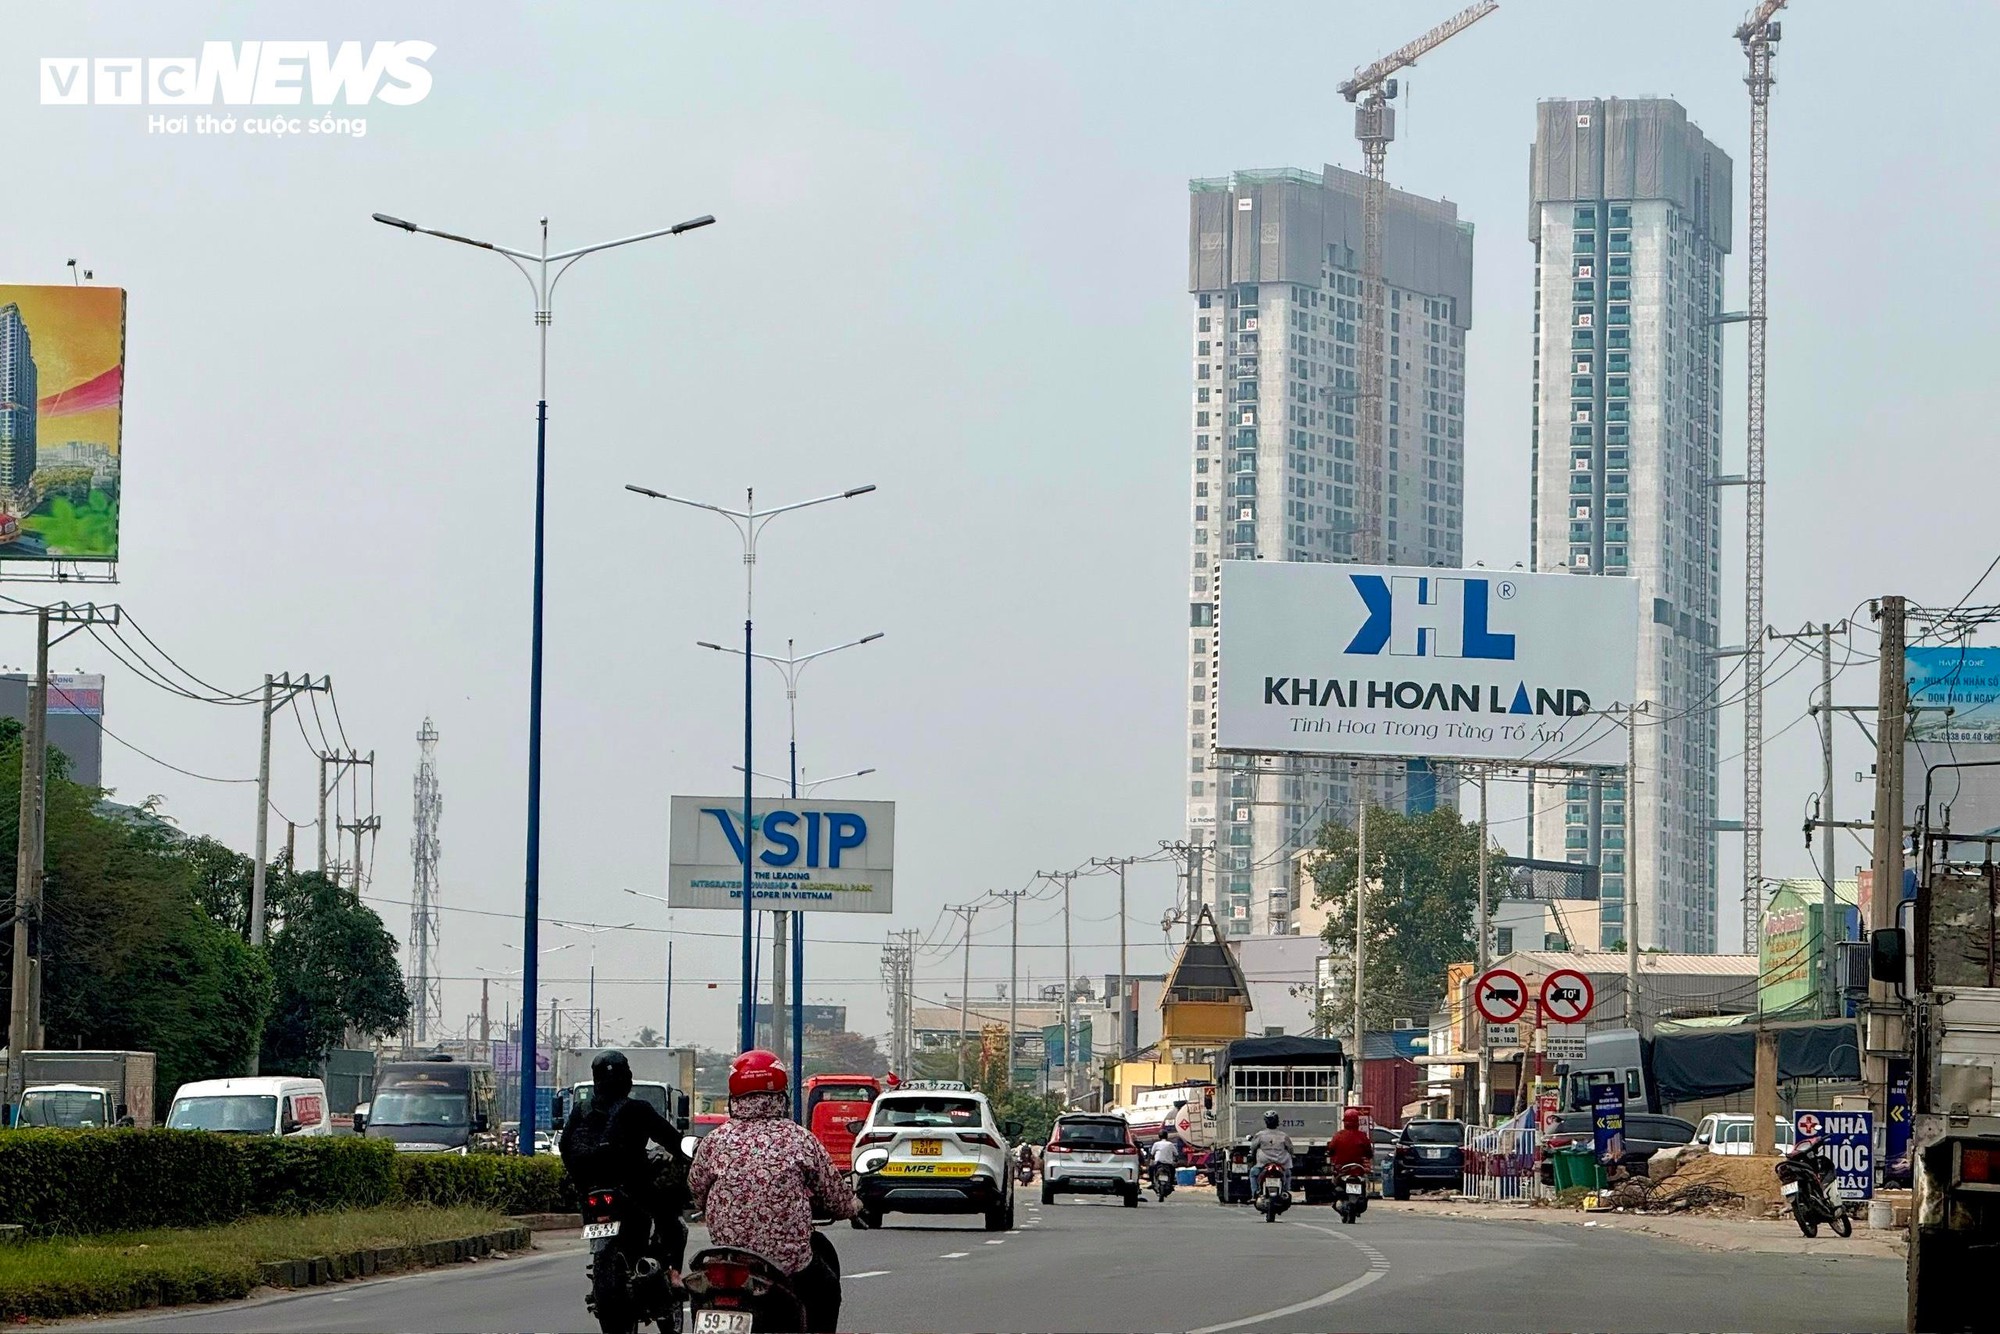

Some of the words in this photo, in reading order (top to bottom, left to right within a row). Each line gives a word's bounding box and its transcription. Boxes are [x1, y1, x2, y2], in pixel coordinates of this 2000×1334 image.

[1578, 116, 1589, 126] 40
[1580, 267, 1590, 276] 34
[1247, 320, 1256, 328] 32
[1580, 316, 1590, 325] 32
[1265, 677, 1357, 708] KHAI
[1367, 681, 1480, 713] HOAN
[1490, 680, 1591, 717] LAND
[1928, 693, 1945, 705] DỌN
[1290, 717, 1331, 734] Tinh
[1337, 719, 1376, 735] Hoa
[1383, 721, 1438, 741] Trong
[1445, 722, 1493, 743] Từng
[1500, 722, 1526, 742] Tổ
[1530, 721, 1564, 743] Ấm
[1238, 810, 1247, 819] 12
[754, 871, 770, 879] THE
[772, 871, 810, 881] LEADING
[750, 881, 789, 890] OWNSHIP
[730, 890, 780, 899] DELOPER
[782, 890, 791, 899] IN
[792, 891, 833, 900] VIETNAM
[1824, 1113, 1868, 1134] NHÀ
[1824, 1135, 1869, 1172] UỐC
[904, 1165, 935, 1173] MPE
[1836, 1173, 1869, 1189] HÂU
[704, 1313, 744, 1331] 59-T2
